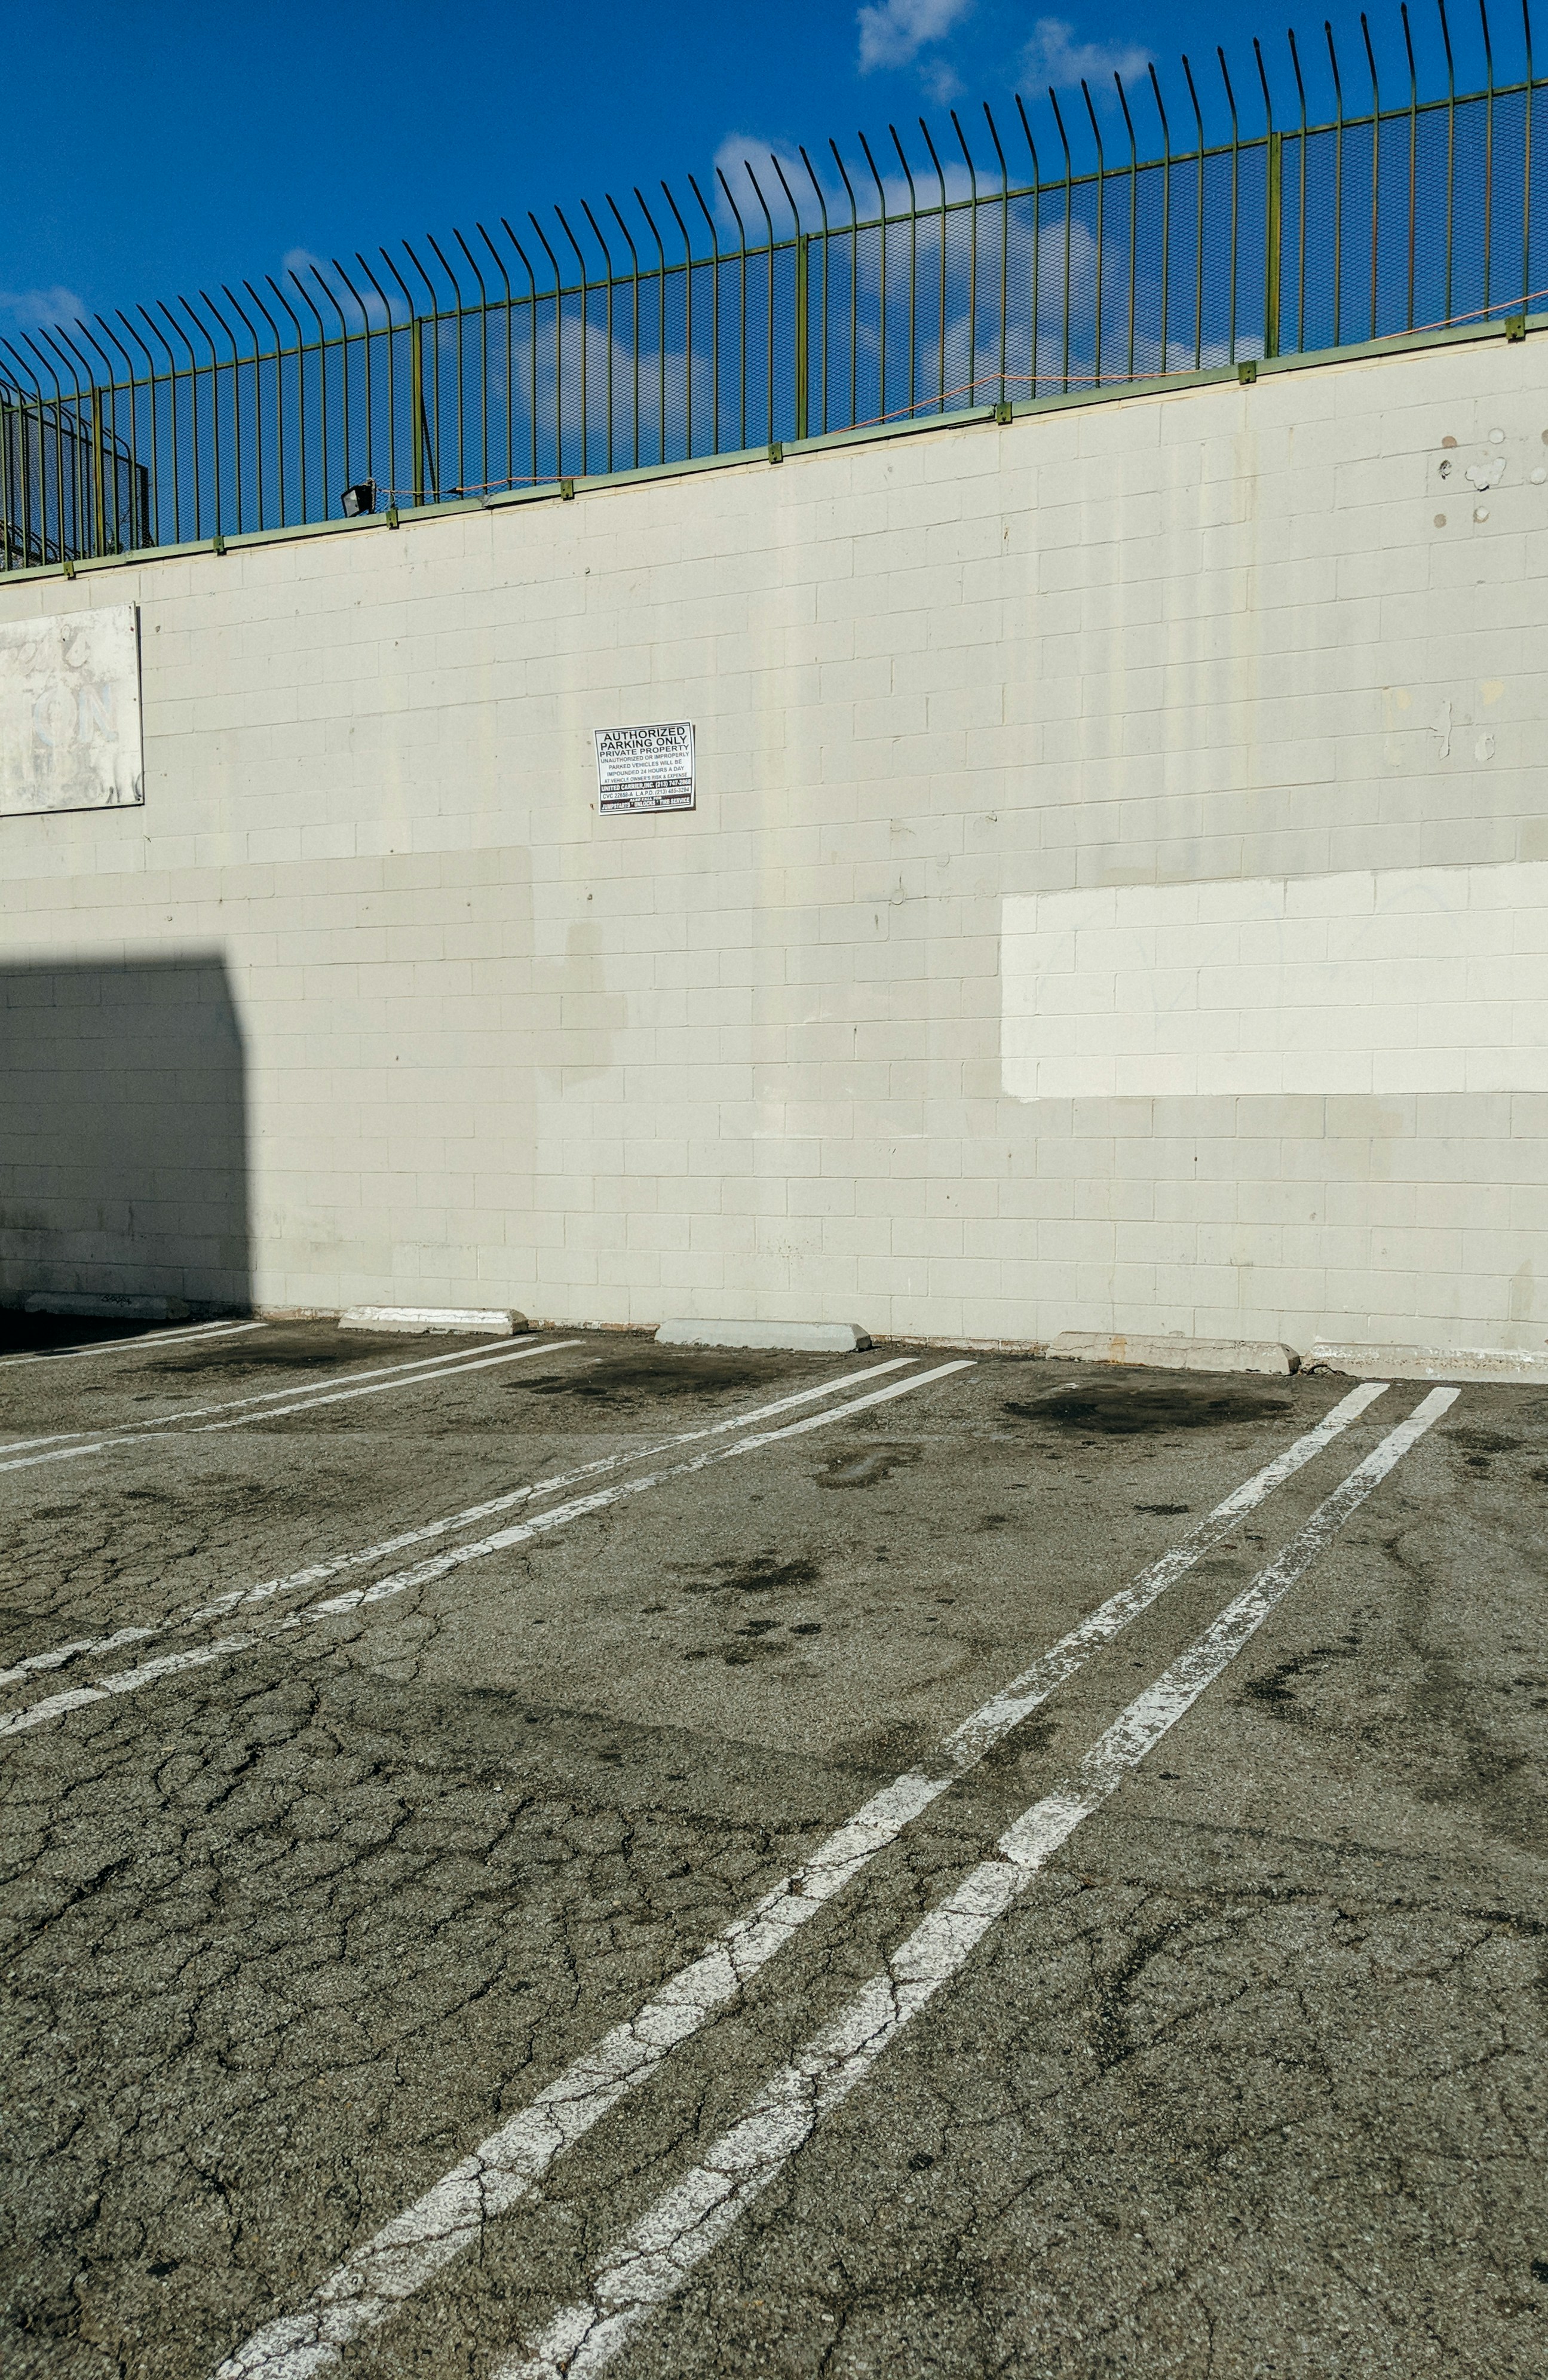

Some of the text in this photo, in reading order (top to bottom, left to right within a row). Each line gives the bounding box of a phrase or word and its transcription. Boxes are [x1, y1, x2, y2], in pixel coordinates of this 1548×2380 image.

[604, 727, 685, 741] AUTHORIZED
[600, 735, 687, 750] PARKING ONLY
[600, 744, 689, 757] PRIVATE PROPERTY
